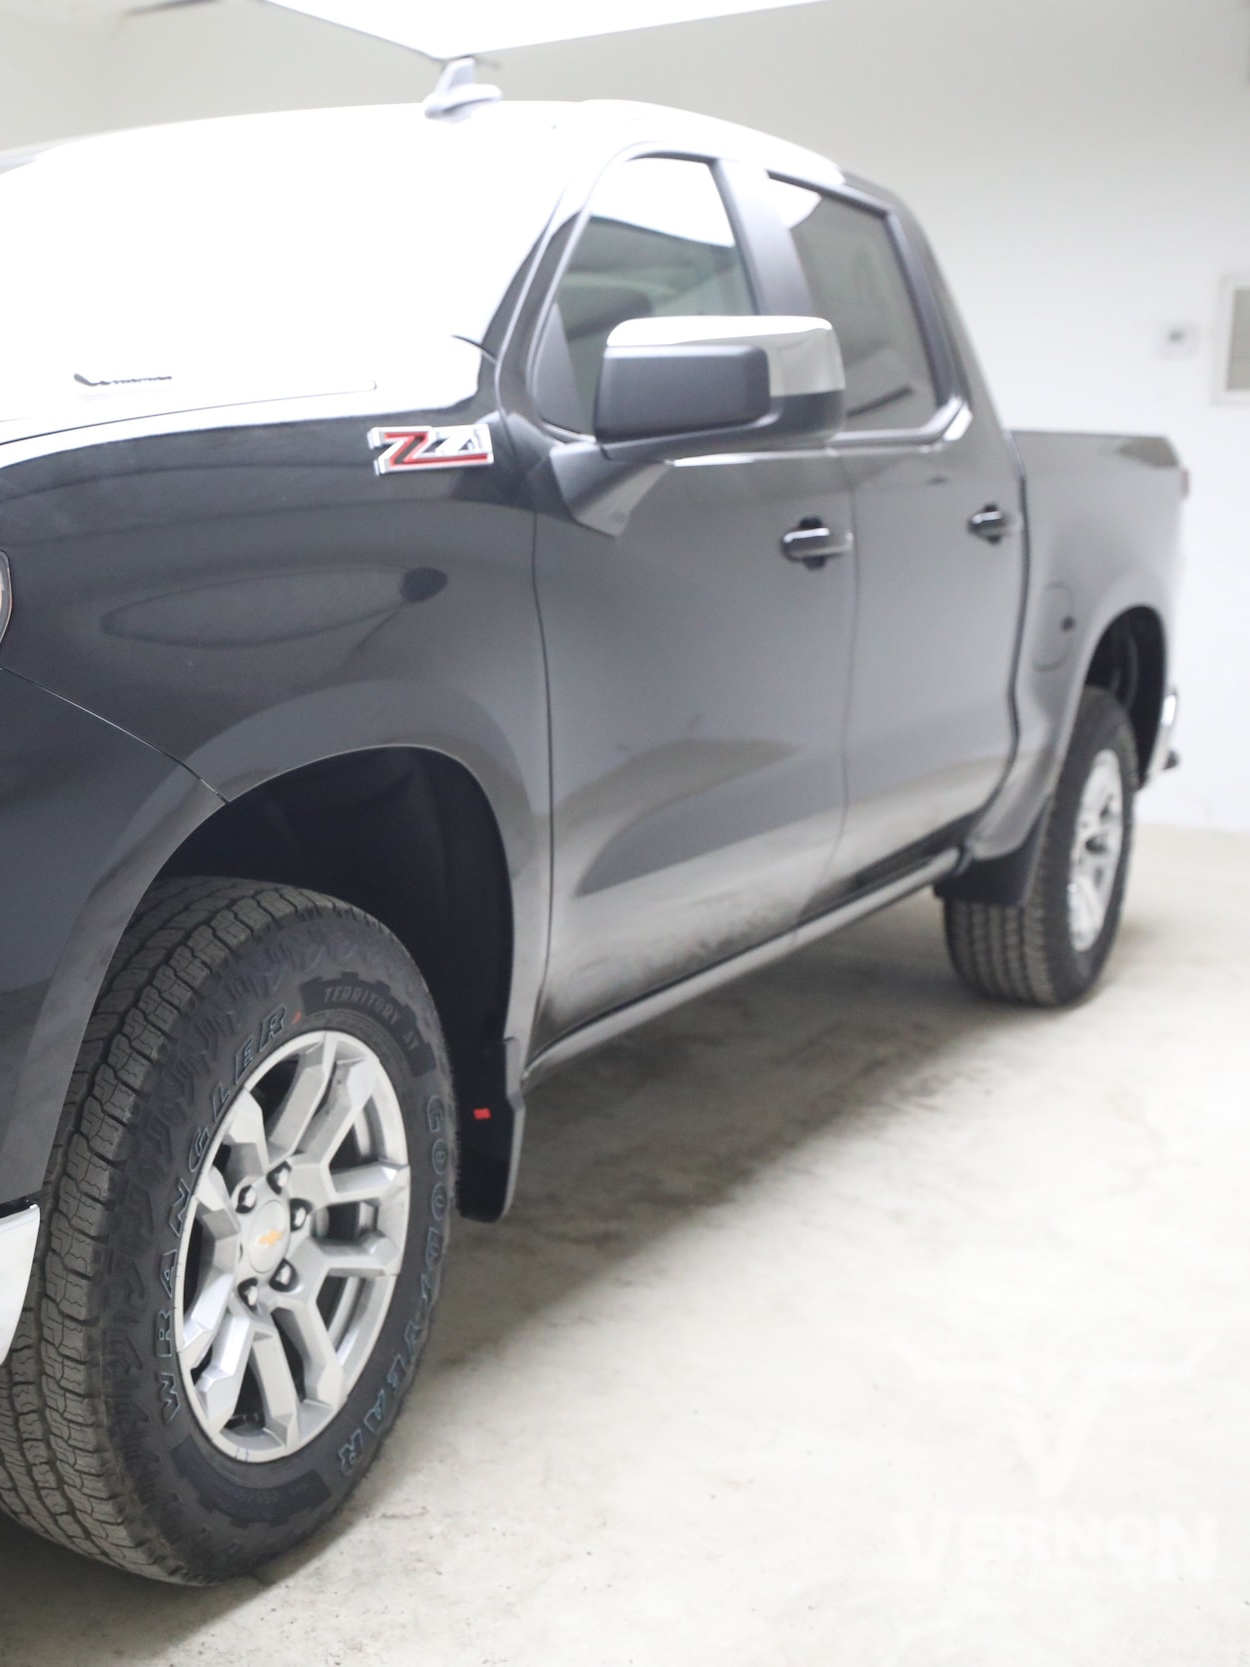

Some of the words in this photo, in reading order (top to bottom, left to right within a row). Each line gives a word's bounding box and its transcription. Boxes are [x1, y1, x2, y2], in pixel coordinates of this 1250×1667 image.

[324, 986, 402, 1026] TERRITORY
[157, 1005, 286, 1425] WRANGLER
[338, 1095, 449, 1476] GOODYEAR
